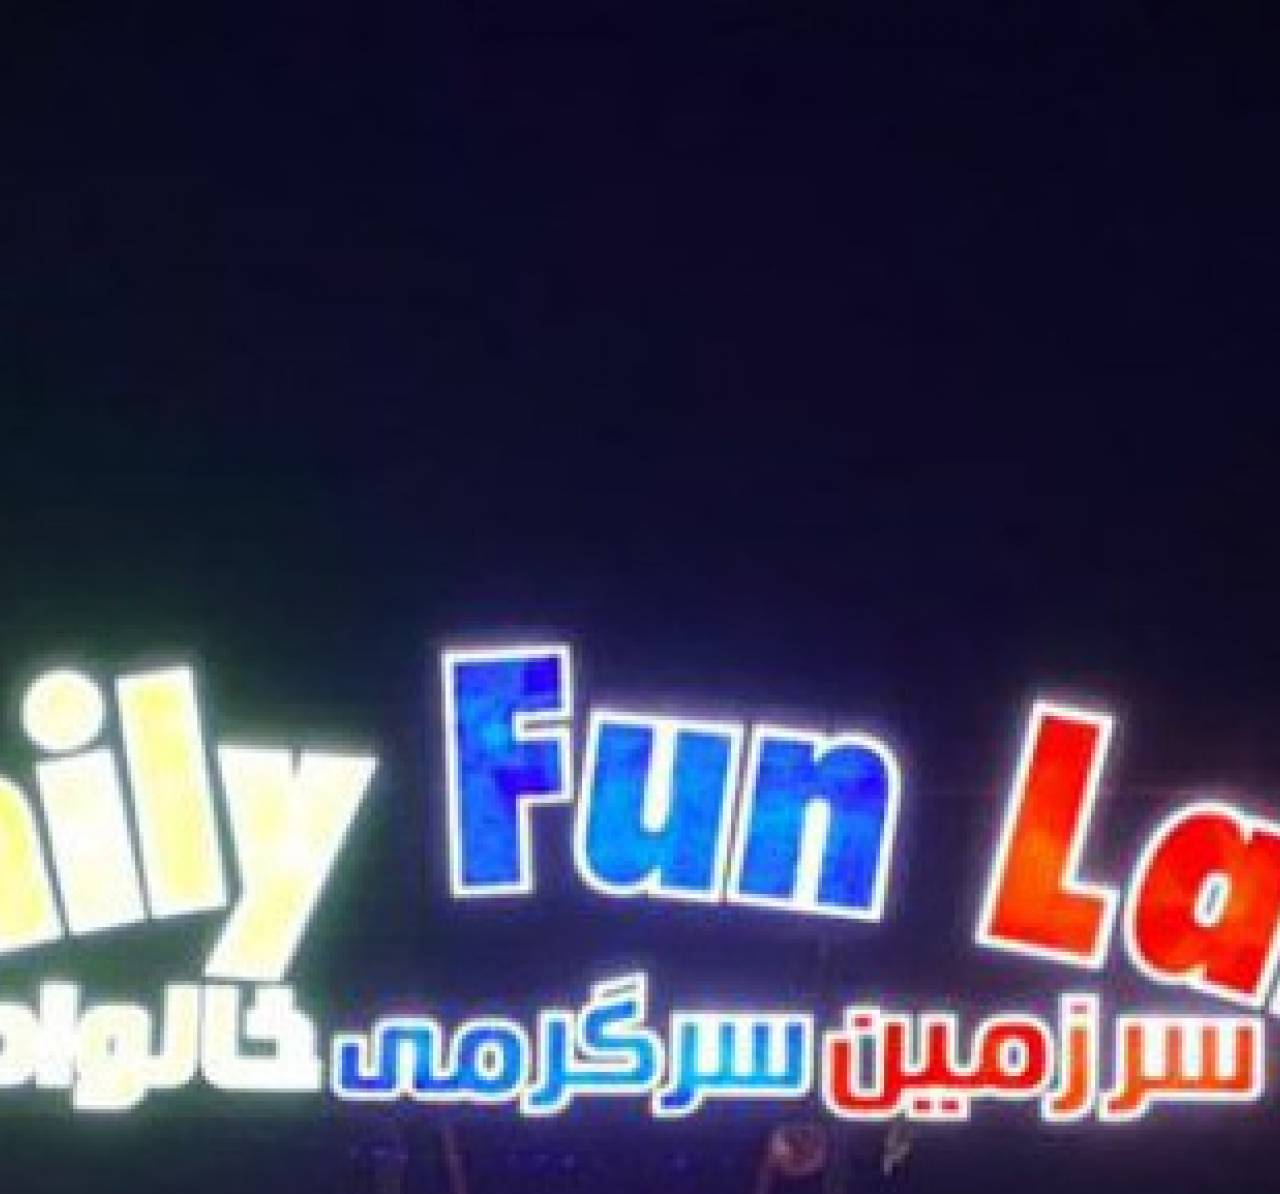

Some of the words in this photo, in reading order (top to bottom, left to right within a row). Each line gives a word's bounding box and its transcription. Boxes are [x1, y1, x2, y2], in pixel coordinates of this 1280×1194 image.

[441, 645, 902, 922] Fun
[332, 973, 813, 1117] سرگرمی
[824, 994, 1265, 1121] سرزمین
